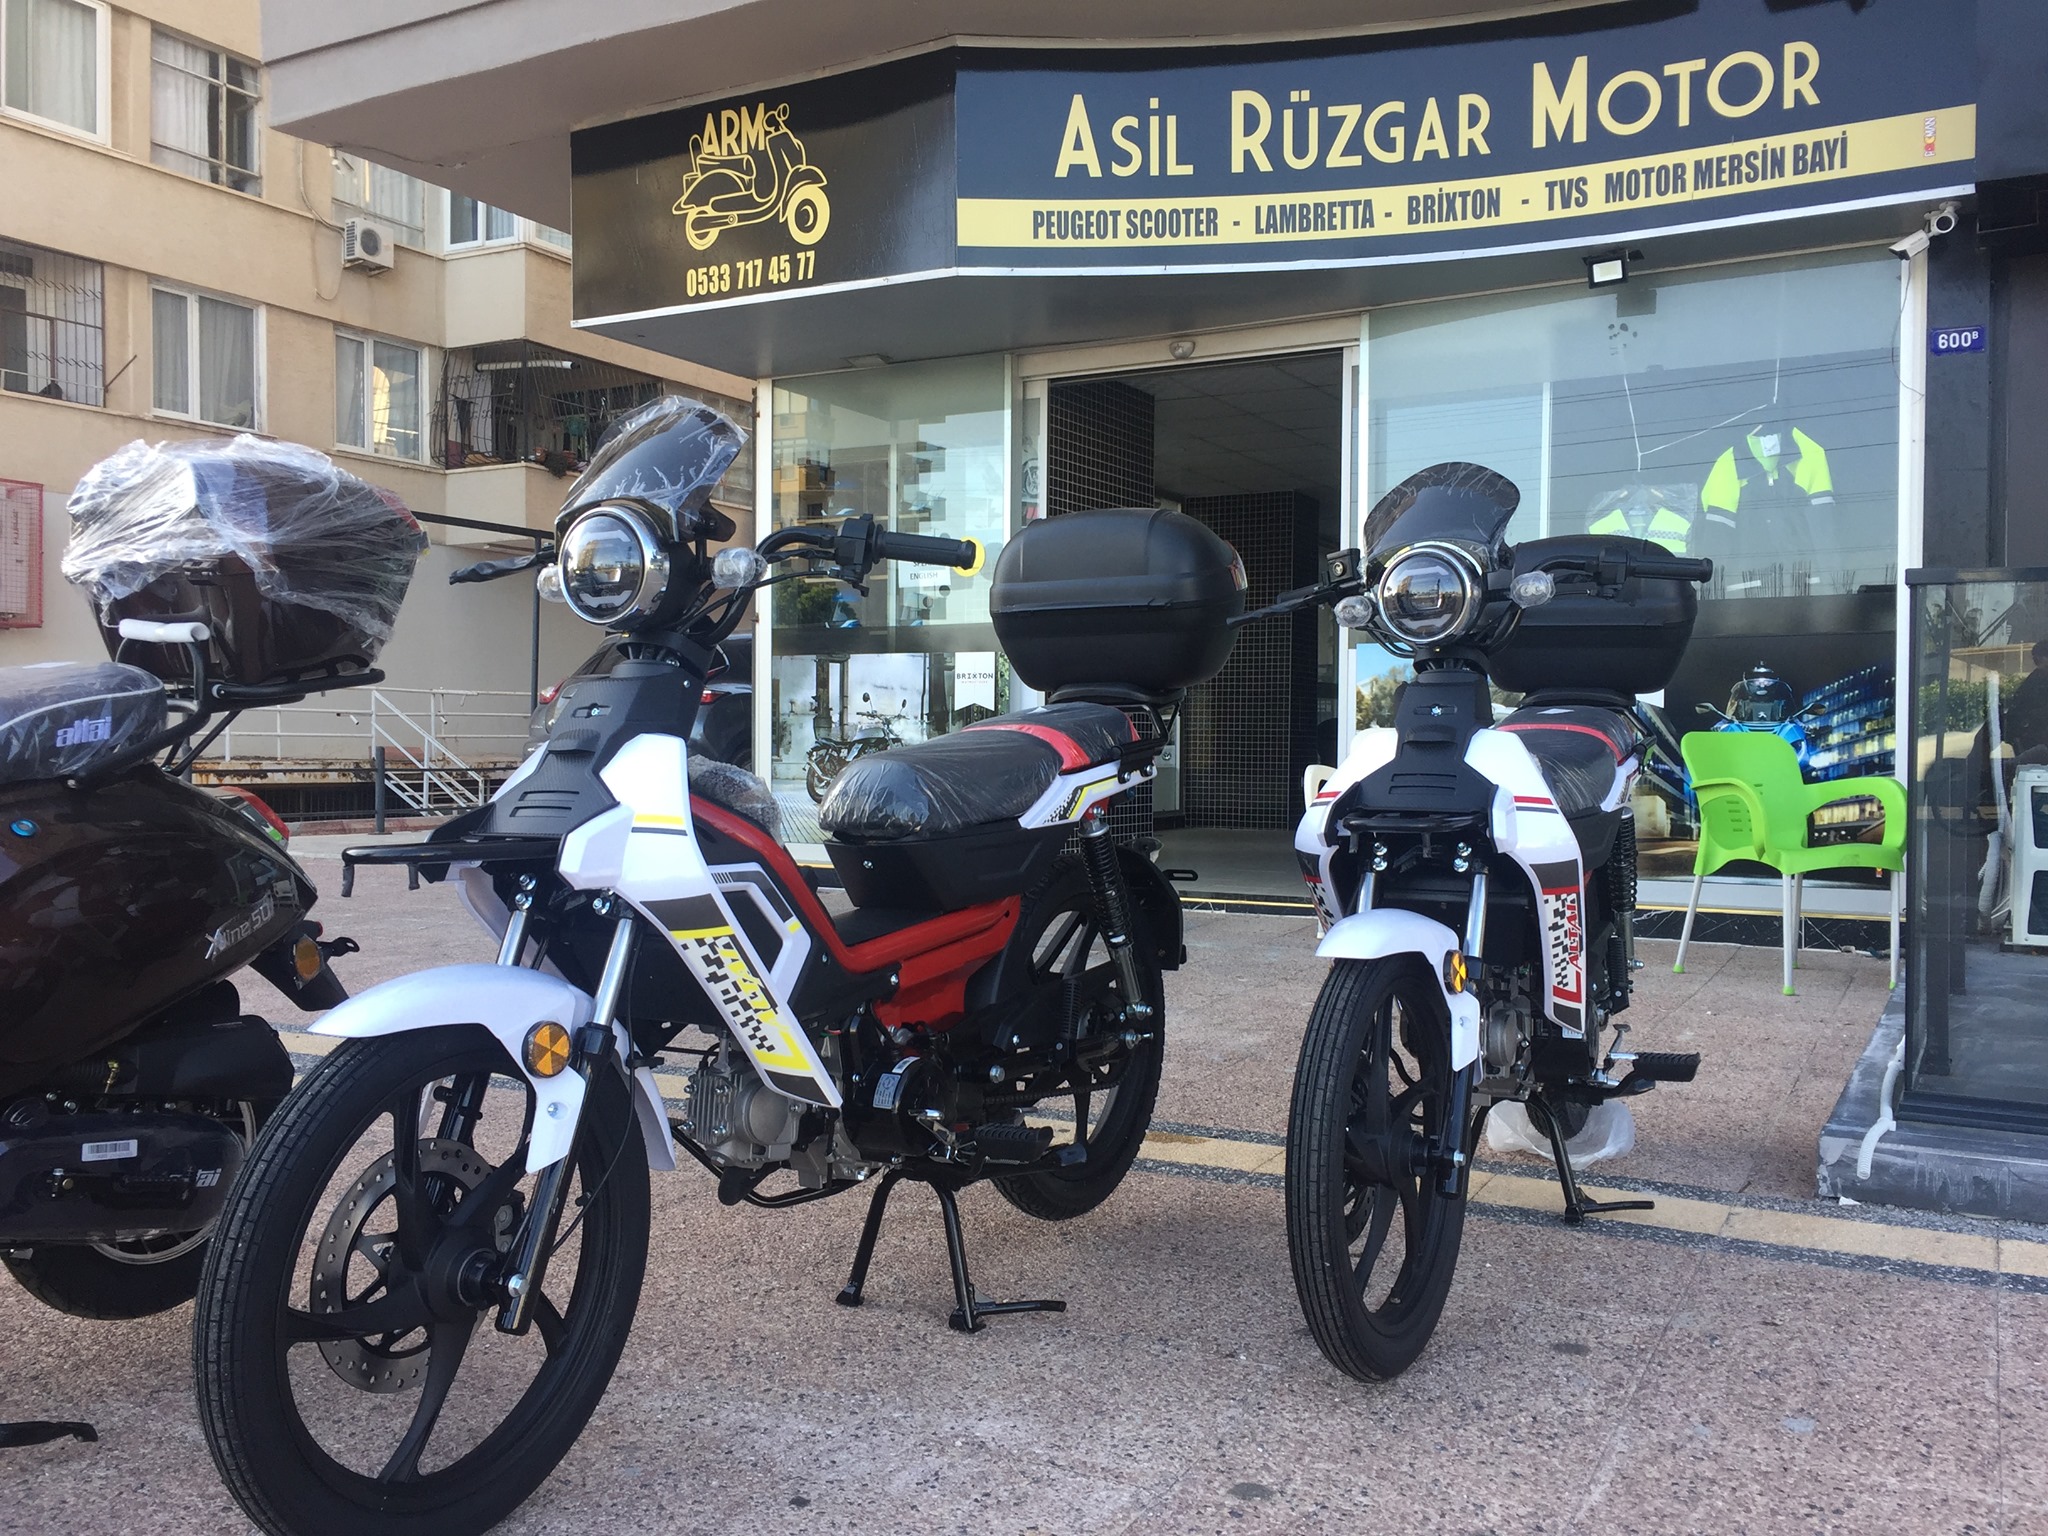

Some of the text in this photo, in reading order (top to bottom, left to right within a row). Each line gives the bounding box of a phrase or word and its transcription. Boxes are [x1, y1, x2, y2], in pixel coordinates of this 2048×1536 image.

[702, 103, 765, 156] ARM
[1231, 90, 1491, 173] RÜZGAR
[1532, 41, 1821, 149] MOTOR
[1032, 210, 1121, 240] PEUGEOT
[1125, 208, 1218, 239] SCOOTER
[1255, 199, 1375, 235] LAMBRETTA
[1544, 176, 1589, 211] TVS
[1604, 163, 1687, 203] MOTOR
[686, 250, 815, 297] 0533 717 45 77
[909, 572, 938, 580] ENGLISH
[956, 672, 994, 680] BRIXTON
